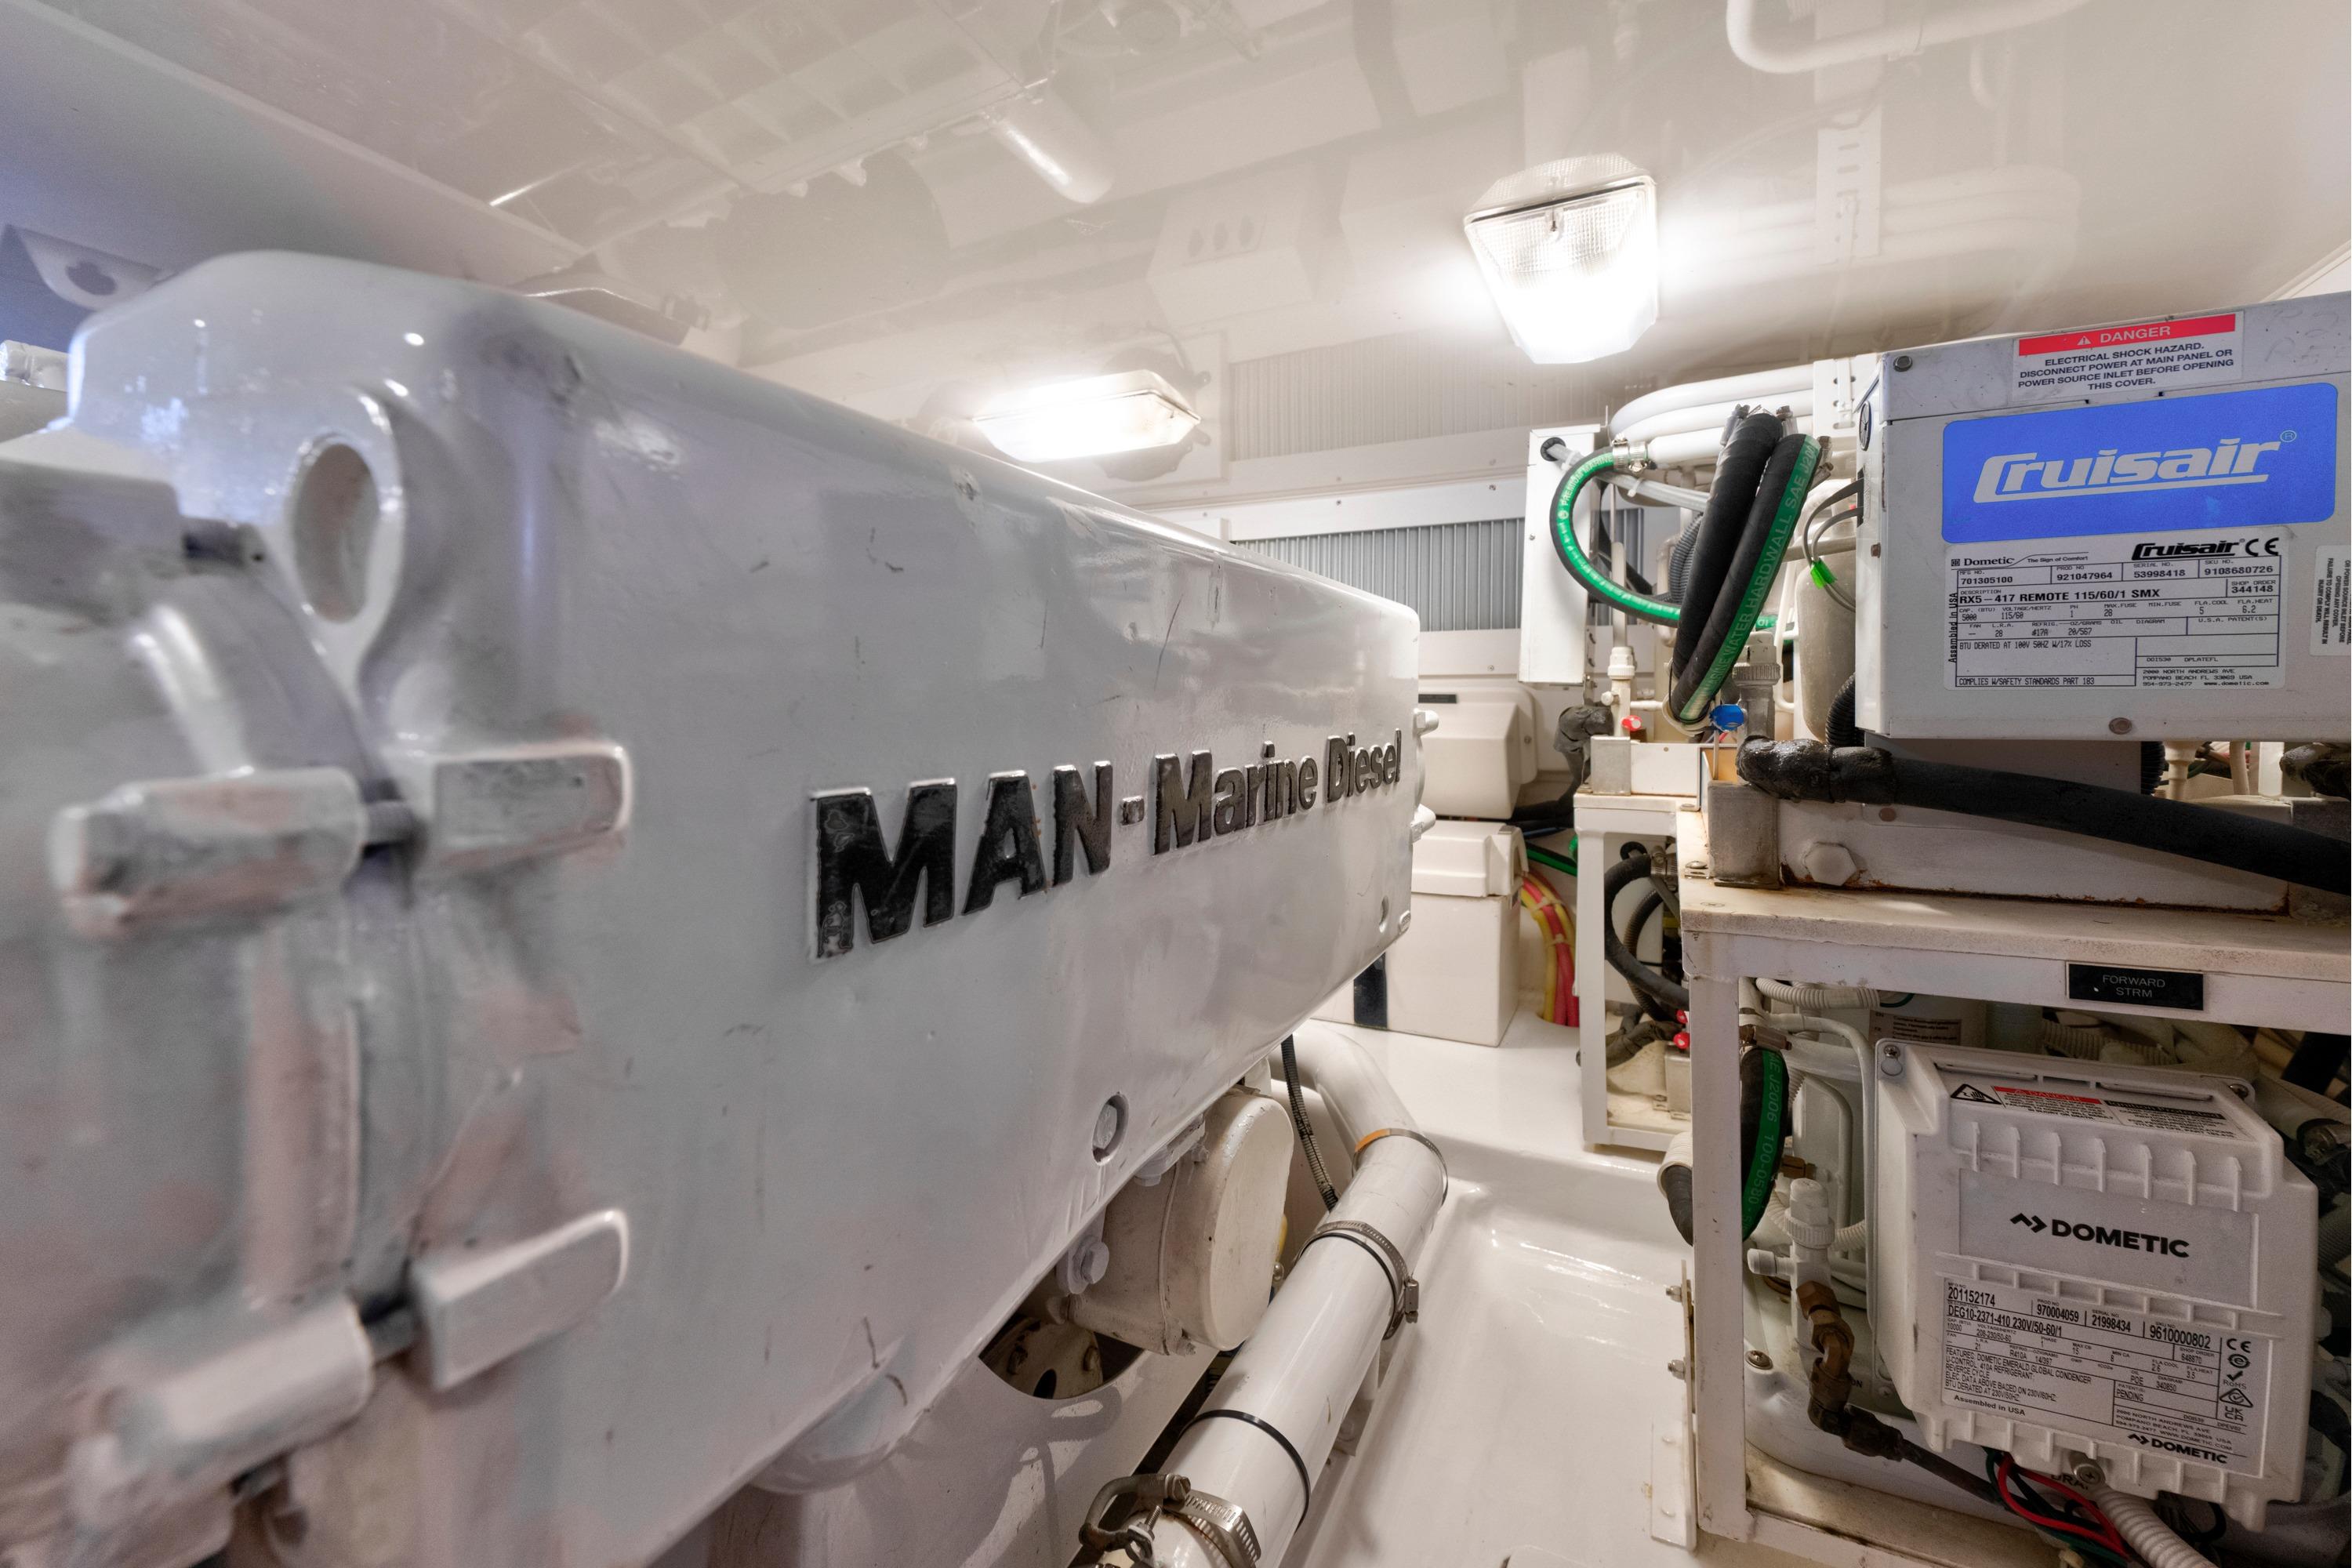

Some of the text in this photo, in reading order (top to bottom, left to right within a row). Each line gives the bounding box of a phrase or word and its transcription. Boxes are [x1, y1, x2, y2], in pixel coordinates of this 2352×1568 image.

[2100, 325, 2171, 343] DANGER
[2045, 343, 2204, 366] ELECTRICAL SHOCK HAZARD.
[2018, 359, 2234, 387] POWER SOURCE INLET BEFORE OPENING
[2020, 365, 2086, 378] DISCONNECT
[2089, 360, 2128, 371] POWER
[2130, 359, 2143, 368] AT
[2147, 356, 2174, 365] MAIN
[2176, 351, 2213, 362] PANEL
[2115, 378, 2155, 388] COVER.
[1973, 438, 2281, 503] Cruisair
[2132, 540, 2239, 561] Cruisair
[1724, 612, 1752, 657] WATER
[1745, 514, 1792, 610] HARDWALL
[1785, 475, 1805, 508] SAE
[1965, 557, 2013, 565] Dometic
[2134, 570, 2185, 579] 53998418
[2205, 566, 2273, 575] 9108680726
[2020, 592, 2069, 601] REMOTE
[2075, 590, 2125, 600] 115/60/1
[2132, 590, 2160, 598] SMX
[2231, 585, 2273, 593] 344148
[1949, 592, 1958, 608] USA
[2199, 606, 2204, 615] 5
[1327, 728, 1402, 804] Diesel
[2103, 974, 2165, 989] FORWARD
[2115, 987, 2153, 998] STRM
[1766, 1072, 1781, 1123] J2006
[2051, 1218, 2190, 1258] DOMETIC
[1948, 1287, 2211, 1348] 201152174 970004059 21998434 9610000802
[1948, 1305, 2062, 1337] DEG10-2371-410 230V/50-60/1
[2010, 1350, 2027, 1359] R410A
[1946, 1364, 1989, 1379] REVERSE CYCLE
[1977, 1354, 2002, 1364] DOMETIC
[2003, 1359, 2030, 1371] EMERALD
[2031, 1365, 2054, 1376] GLOBAL
[1980, 1363, 1992, 1371] 410A
[1946, 1380, 1956, 1388] BTU
[1958, 1382, 1983, 1394] DERATED
[1962, 1376, 1976, 1385] DATA
[1978, 1378, 1996, 1388] ABOVE
[2117, 1388, 2143, 1402] PENDING
[1955, 1395, 1996, 1409] Assembled
[2009, 1406, 2025, 1416] USA
[2151, 1439, 2227, 1464] DOMETIC
